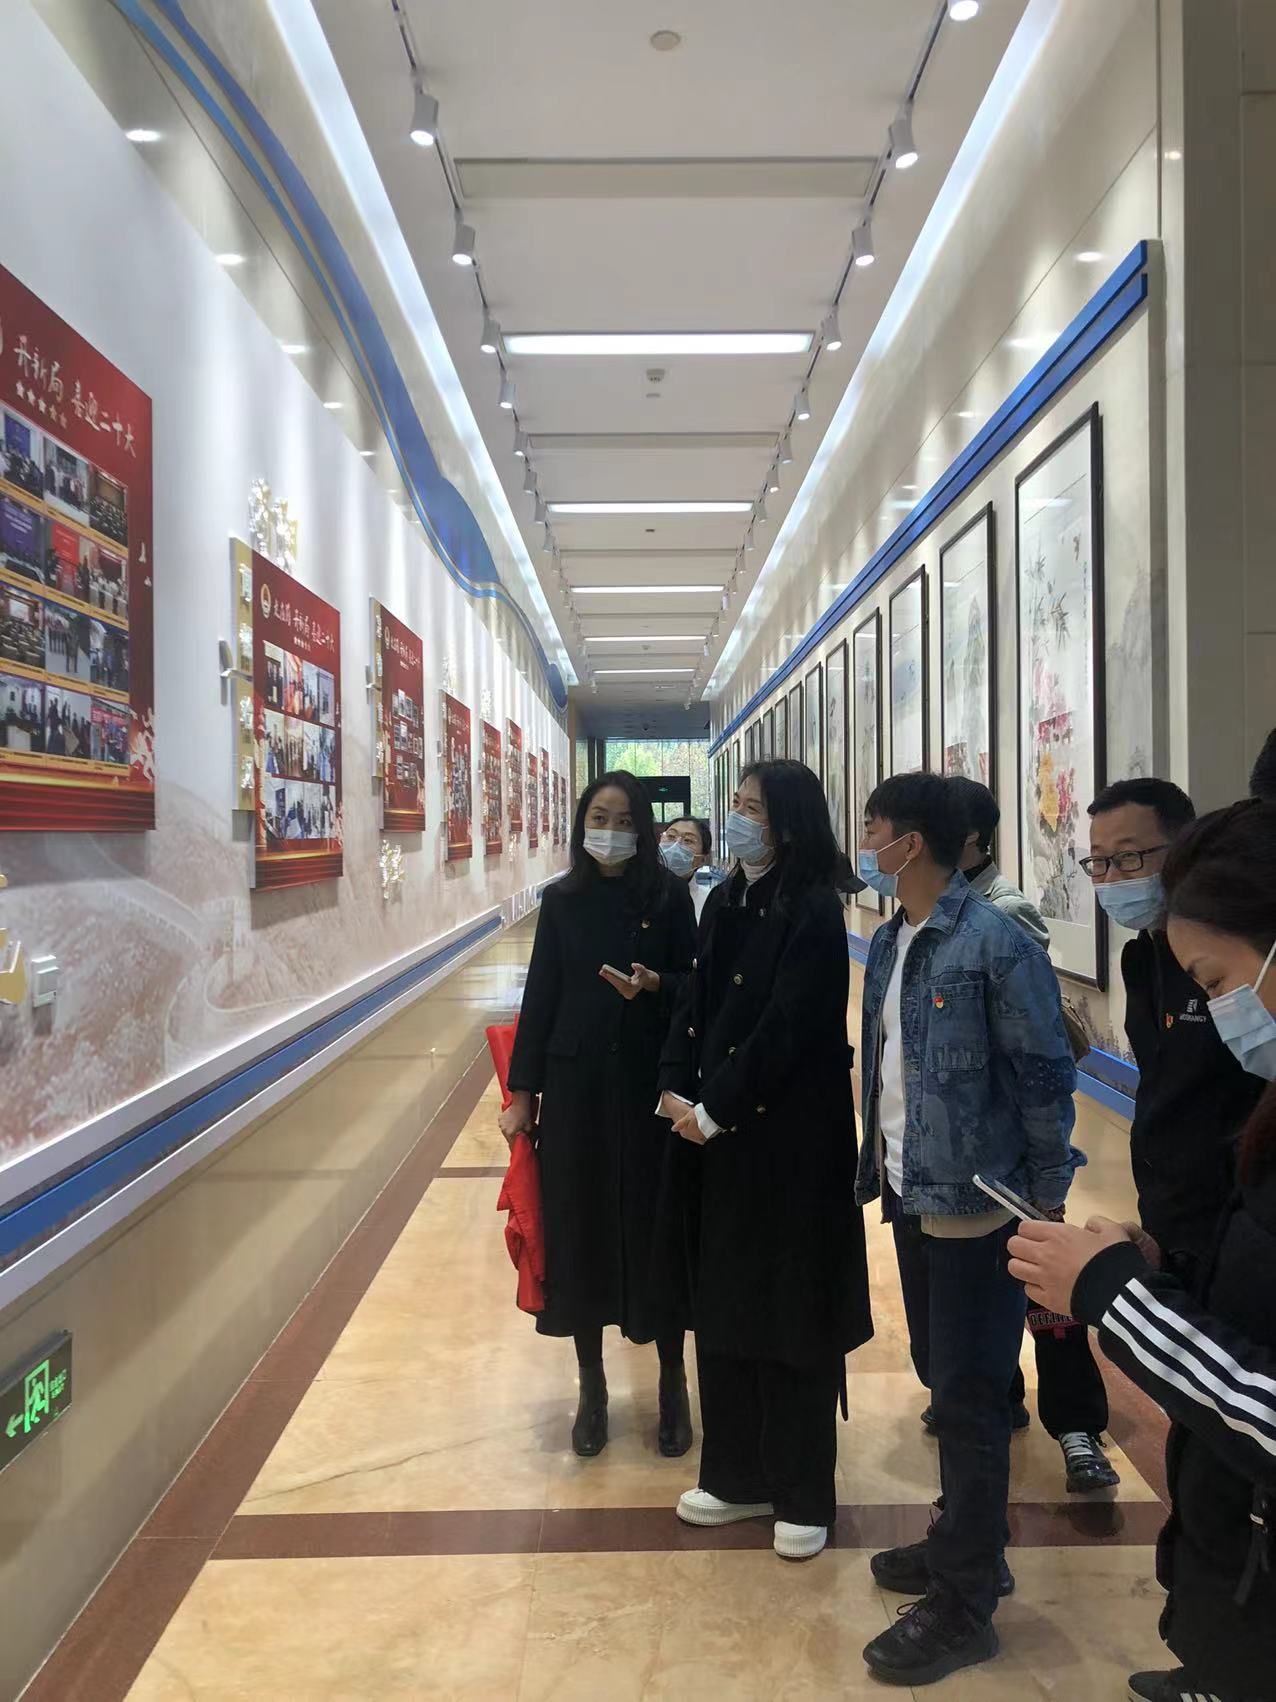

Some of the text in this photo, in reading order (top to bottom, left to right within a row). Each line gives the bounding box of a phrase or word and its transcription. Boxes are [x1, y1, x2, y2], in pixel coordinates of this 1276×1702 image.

[14, 335, 136, 458] 开新局 喜迎二十大
